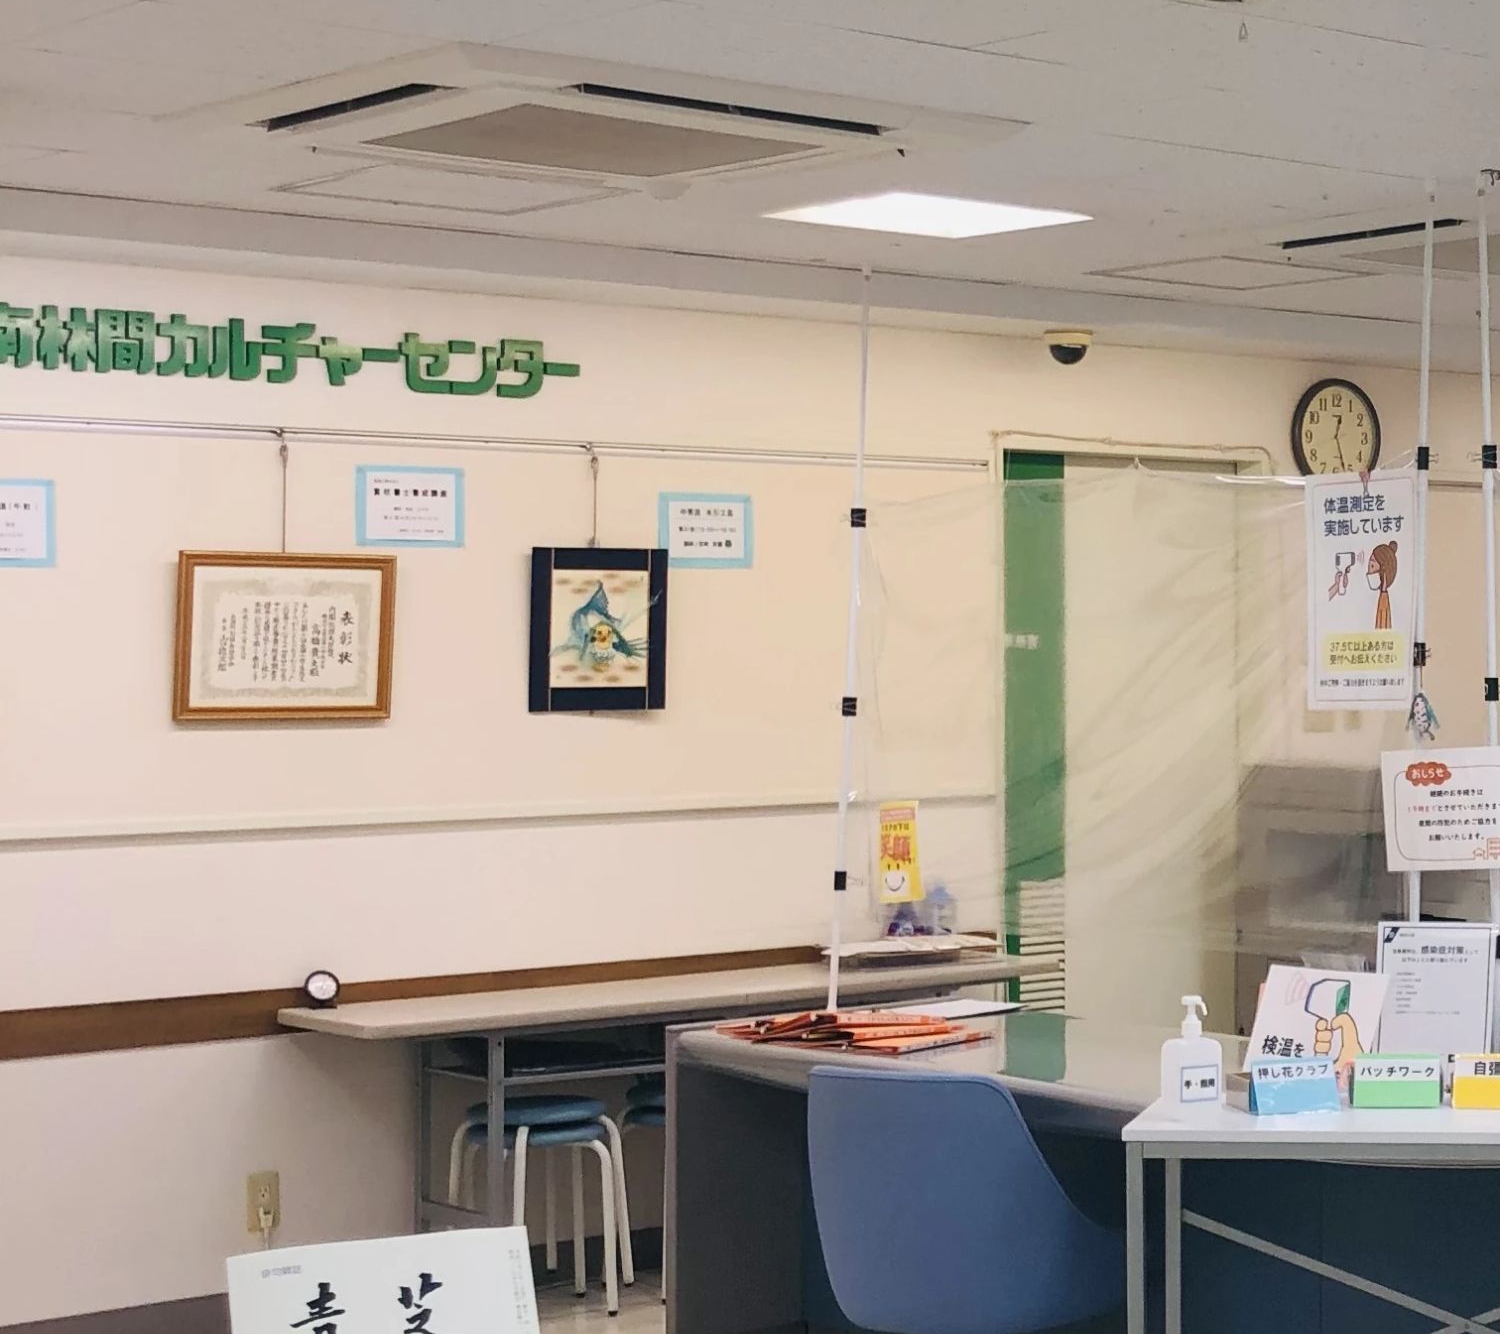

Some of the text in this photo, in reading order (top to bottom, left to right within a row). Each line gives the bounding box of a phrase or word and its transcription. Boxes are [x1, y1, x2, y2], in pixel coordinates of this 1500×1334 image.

[1319, 398, 1327, 411] 11
[1331, 393, 1343, 408] 12
[1348, 399, 1353, 413] 1
[1309, 410, 1320, 425] 10
[1356, 413, 1364, 427] 2
[1305, 429, 1313, 443] 9
[1361, 432, 1368, 446] 3
[1309, 448, 1318, 462] 8
[1324, 494, 1386, 515] 体温測定を
[1324, 515, 1405, 537] 実施しています
[1411, 768, 1445, 779] おしらせ
[1261, 1034, 1305, 1058] 検温を
[1258, 1063, 1329, 1080] 押し花クラブ
